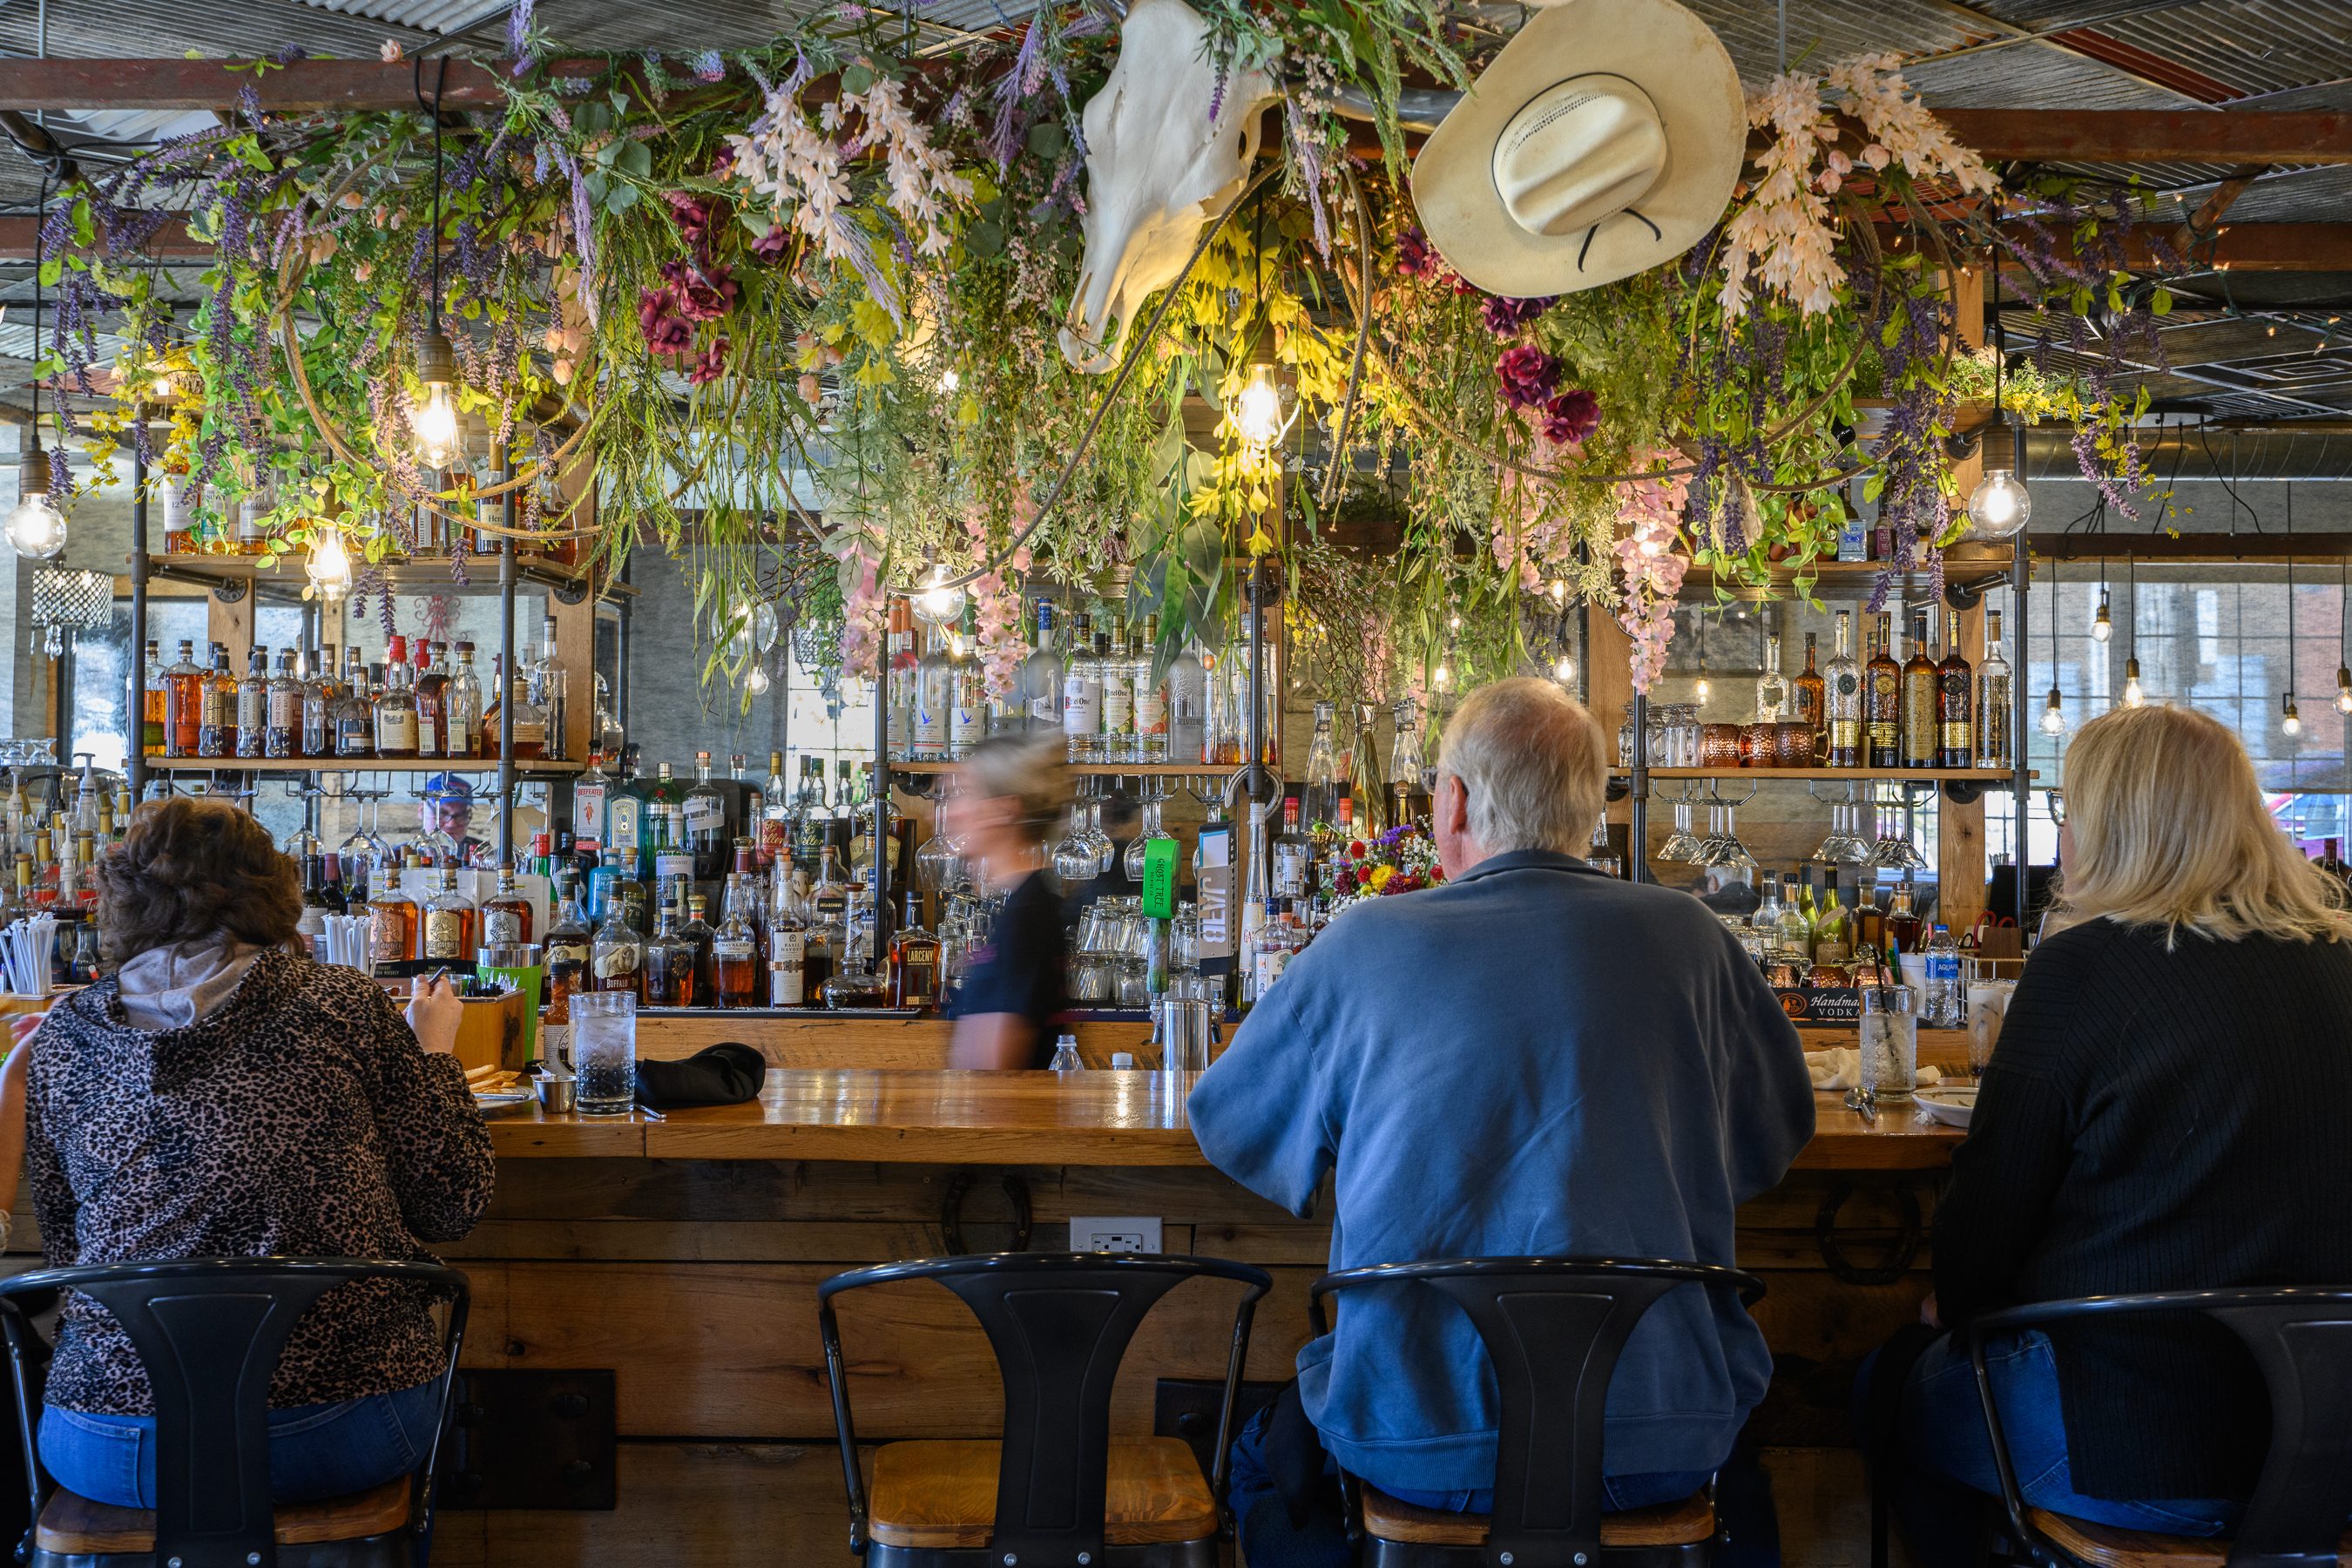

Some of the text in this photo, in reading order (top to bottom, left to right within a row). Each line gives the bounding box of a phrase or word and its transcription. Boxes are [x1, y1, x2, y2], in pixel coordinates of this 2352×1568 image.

[578, 788, 603, 797] BEEFEATER
[763, 833, 784, 844] eller
[1154, 858, 1166, 909] GHOST TREE
[907, 950, 933, 963] LARCENY
[606, 978, 628, 989] BUFFALO
[1810, 993, 1860, 1006] Handma
